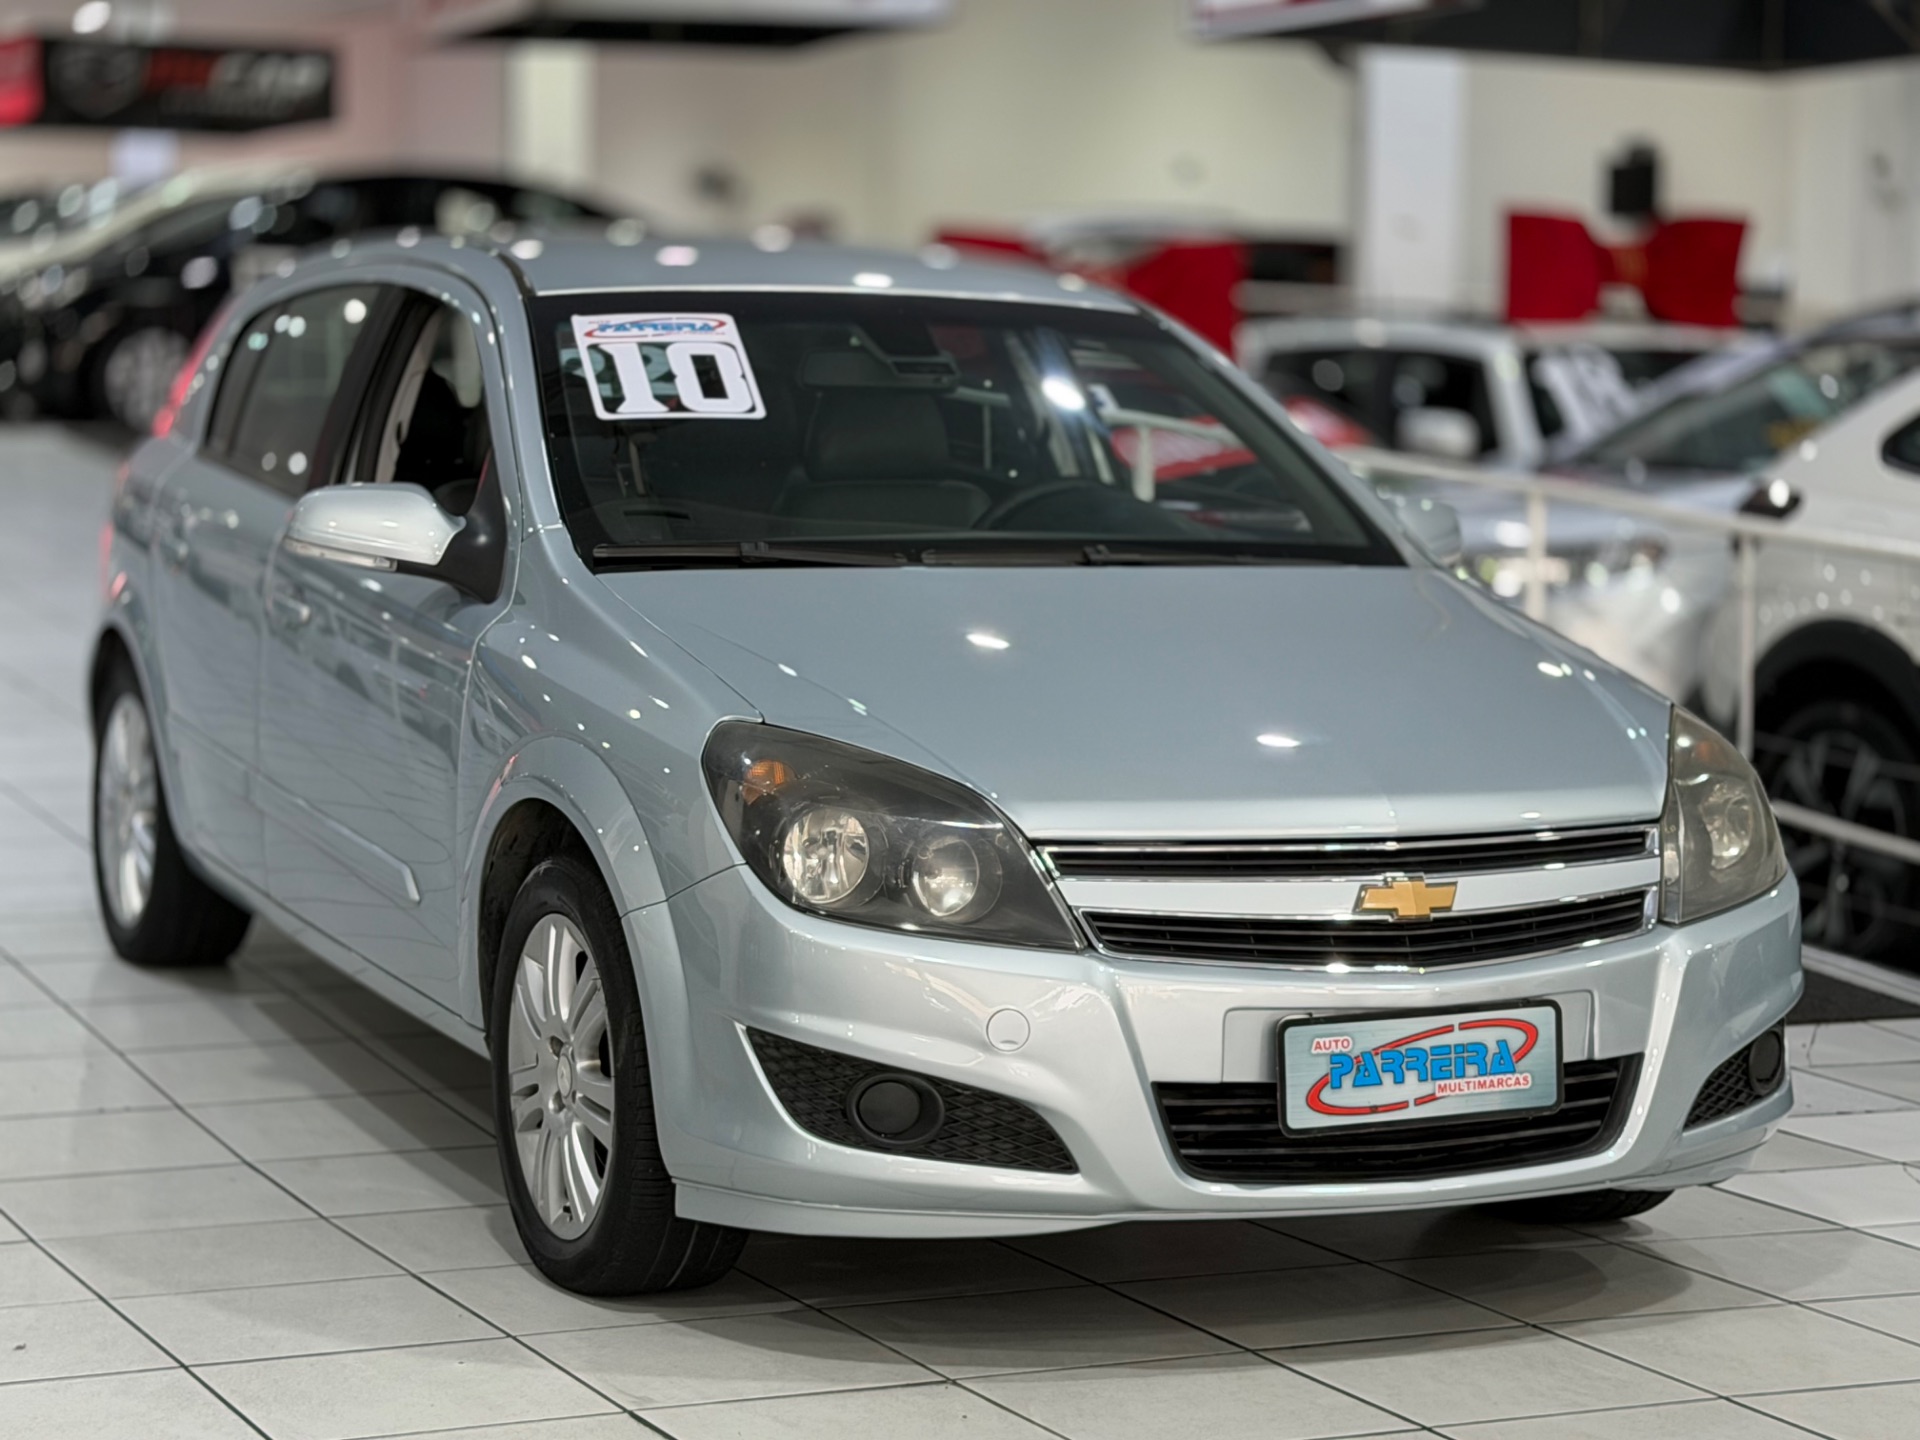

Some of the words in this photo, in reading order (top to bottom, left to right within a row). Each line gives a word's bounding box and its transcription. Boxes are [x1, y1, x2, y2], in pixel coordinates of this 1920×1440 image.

[597, 342, 754, 413] 10
[1313, 1038, 1351, 1052] AUTO
[1329, 1039, 1517, 1090] PARREIRA
[1437, 1074, 1531, 1094] MULTIMARCAS
